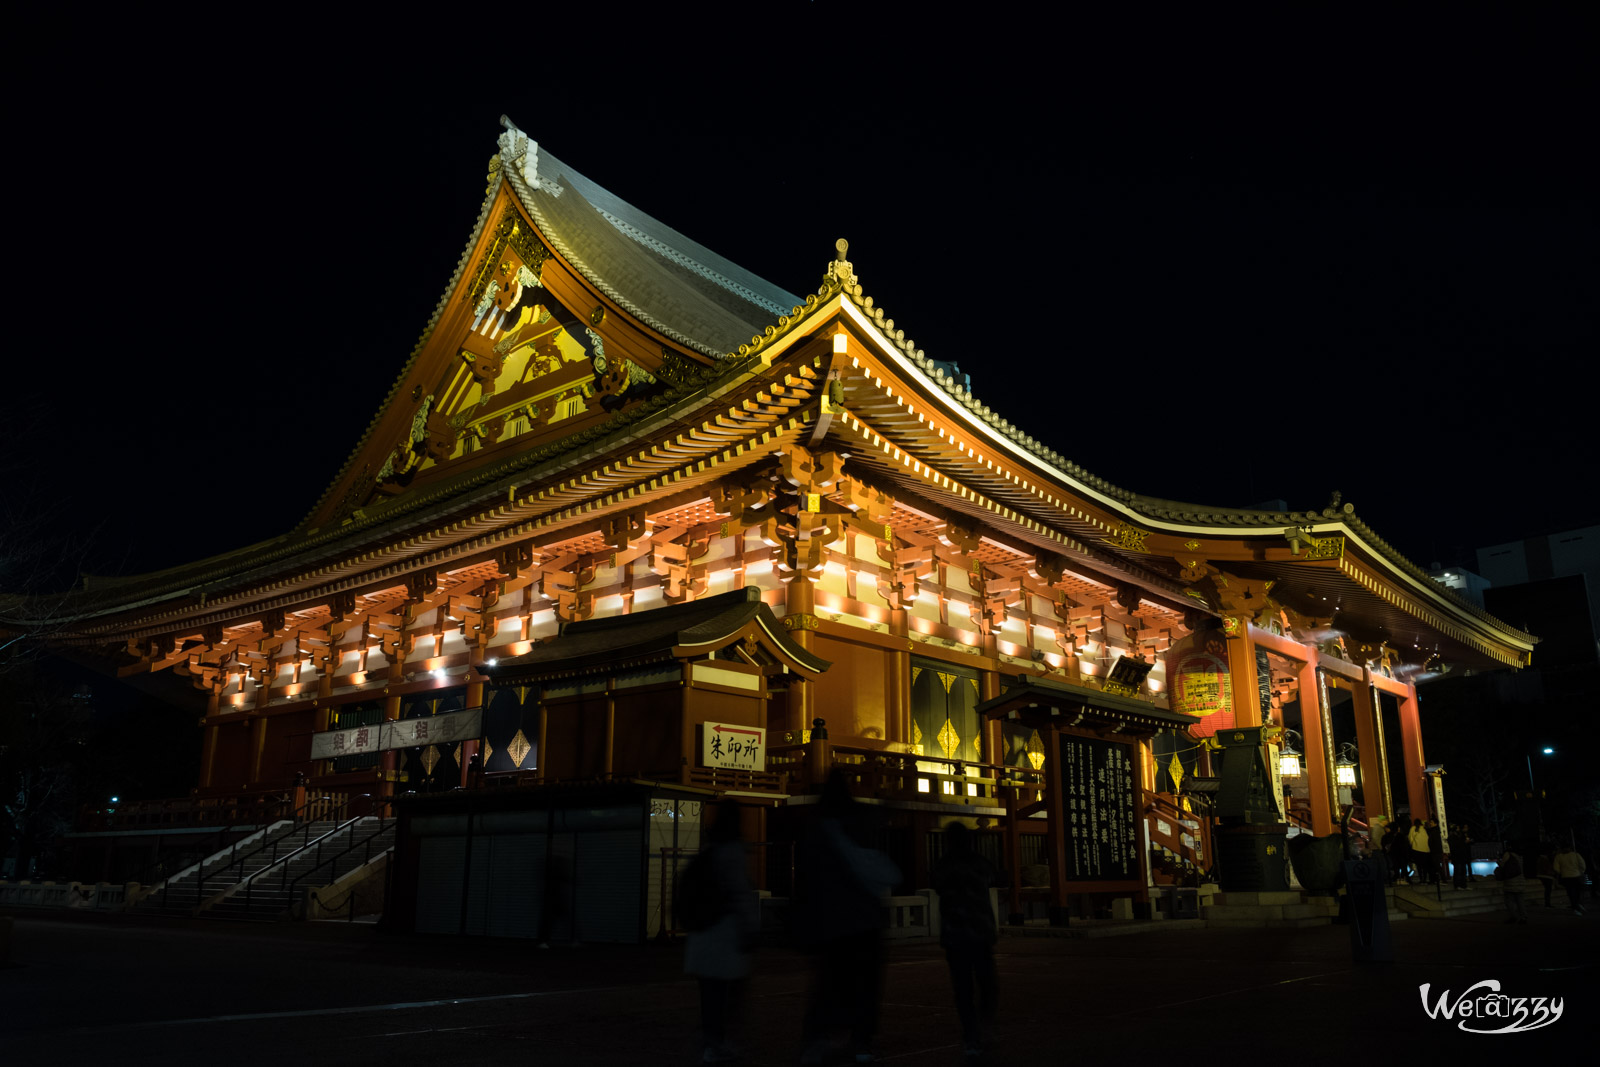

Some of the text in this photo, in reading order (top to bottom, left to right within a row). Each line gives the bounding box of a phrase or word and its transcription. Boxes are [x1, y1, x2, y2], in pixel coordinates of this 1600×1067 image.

[710, 734, 759, 763] 朱印所
[651, 800, 700, 816] おみくじ
